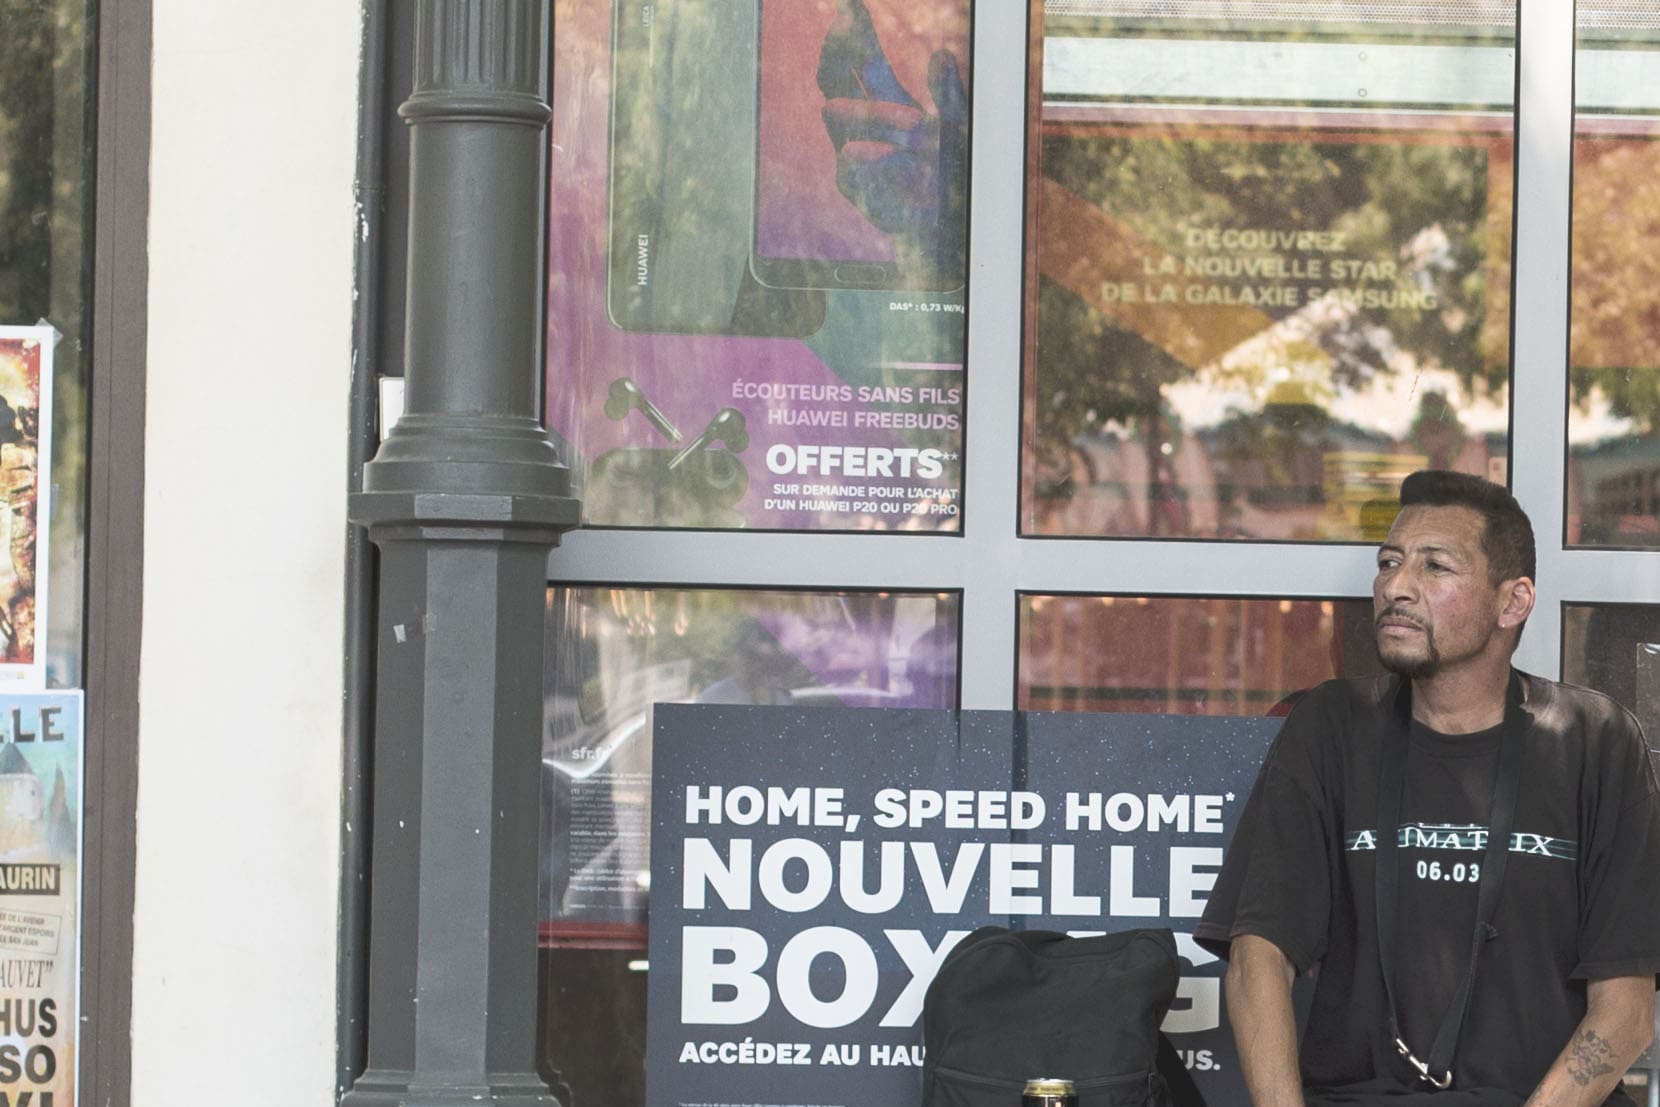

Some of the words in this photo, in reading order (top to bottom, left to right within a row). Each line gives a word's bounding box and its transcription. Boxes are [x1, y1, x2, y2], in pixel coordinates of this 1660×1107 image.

[1187, 226, 1346, 252] DÉCOUVREZ
[637, 234, 648, 286] HUAWEI
[1143, 256, 1175, 275] LA
[1185, 256, 1322, 279] NOUVELLE
[1330, 260, 1397, 280] STAR
[1102, 282, 1134, 302] DE
[1145, 283, 1177, 303] LA
[1185, 284, 1298, 306] GALAXIE
[1307, 286, 1438, 310] SAMSUNG
[732, 378, 852, 401] ÉCOUTEURS
[858, 387, 913, 404] SANS
[919, 388, 961, 405] FILS
[768, 408, 847, 427] HUAWEI
[855, 411, 960, 431] FREEBUDS
[773, 483, 799, 496] SUR
[803, 484, 865, 498] DEMANDE
[869, 486, 904, 499] POUR
[907, 487, 958, 500] L'ACHAT
[764, 499, 795, 511] D'UN
[799, 500, 849, 512] HUAWEI
[853, 501, 877, 514] P20
[881, 502, 899, 514] OU
[903, 503, 928, 515] P20
[931, 503, 957, 515] PRO
[0, 708, 64, 743] LE
[684, 785, 860, 833] HOME,
[873, 788, 1046, 830] SPEED
[682, 837, 1224, 918] NOUVELLE
[1416, 860, 1480, 883] 06.03
[0, 1044, 57, 1084] SO
[678, 1036, 812, 1065] ACCÉDEZ
[819, 1044, 860, 1066] AU
[869, 1044, 926, 1067] HAU
